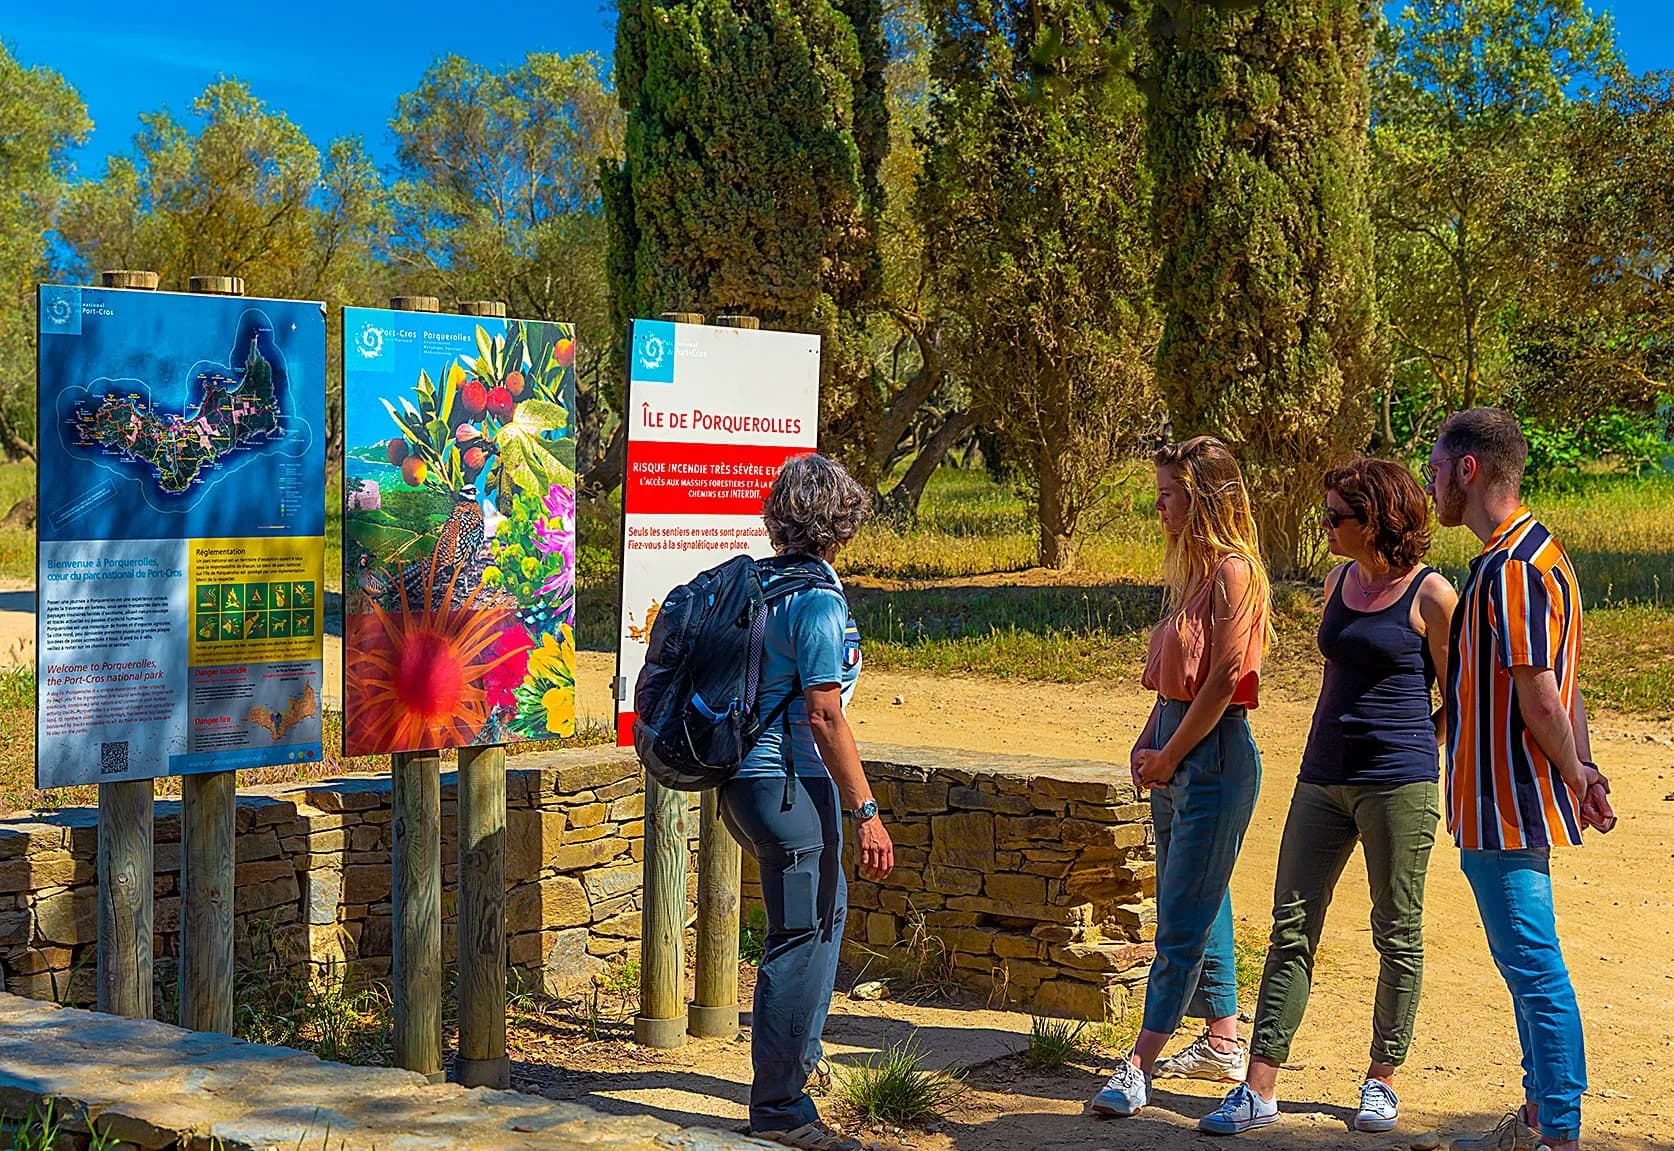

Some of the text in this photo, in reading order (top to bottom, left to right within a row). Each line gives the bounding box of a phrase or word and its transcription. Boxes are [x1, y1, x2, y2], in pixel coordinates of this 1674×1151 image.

[82, 308, 113, 316] Port-Cros
[380, 328, 417, 338] Port-Cros
[423, 331, 471, 342] Porquerolles
[632, 462, 666, 473] RISQUE
[668, 463, 708, 474] INCENDIE
[710, 462, 730, 475] TRÈS
[733, 463, 763, 476] SÉVÈRE
[766, 466, 776, 475] ET
[640, 477, 665, 486] L'ACCÈS
[681, 479, 707, 487] MASSIFS
[747, 480, 754, 488] ET
[755, 479, 759, 488] À
[688, 490, 762, 499] CHEMINS EST INTERDIT.
[628, 527, 648, 536] Seuls
[650, 527, 660, 536] les
[662, 527, 690, 536] sentiers
[701, 528, 718, 536] verts
[720, 528, 734, 536] sont
[736, 527, 768, 538] praticable
[628, 539, 750, 551] Fiez-vous à la signalétique en place.
[47, 560, 94, 568] Bienvenue
[96, 559, 101, 568] à
[47, 568, 182, 582] cœur du parc national de Port-Cros
[47, 664, 87, 674] Welcome
[91, 663, 99, 672] to
[47, 670, 163, 686] the Port-Cros national park
